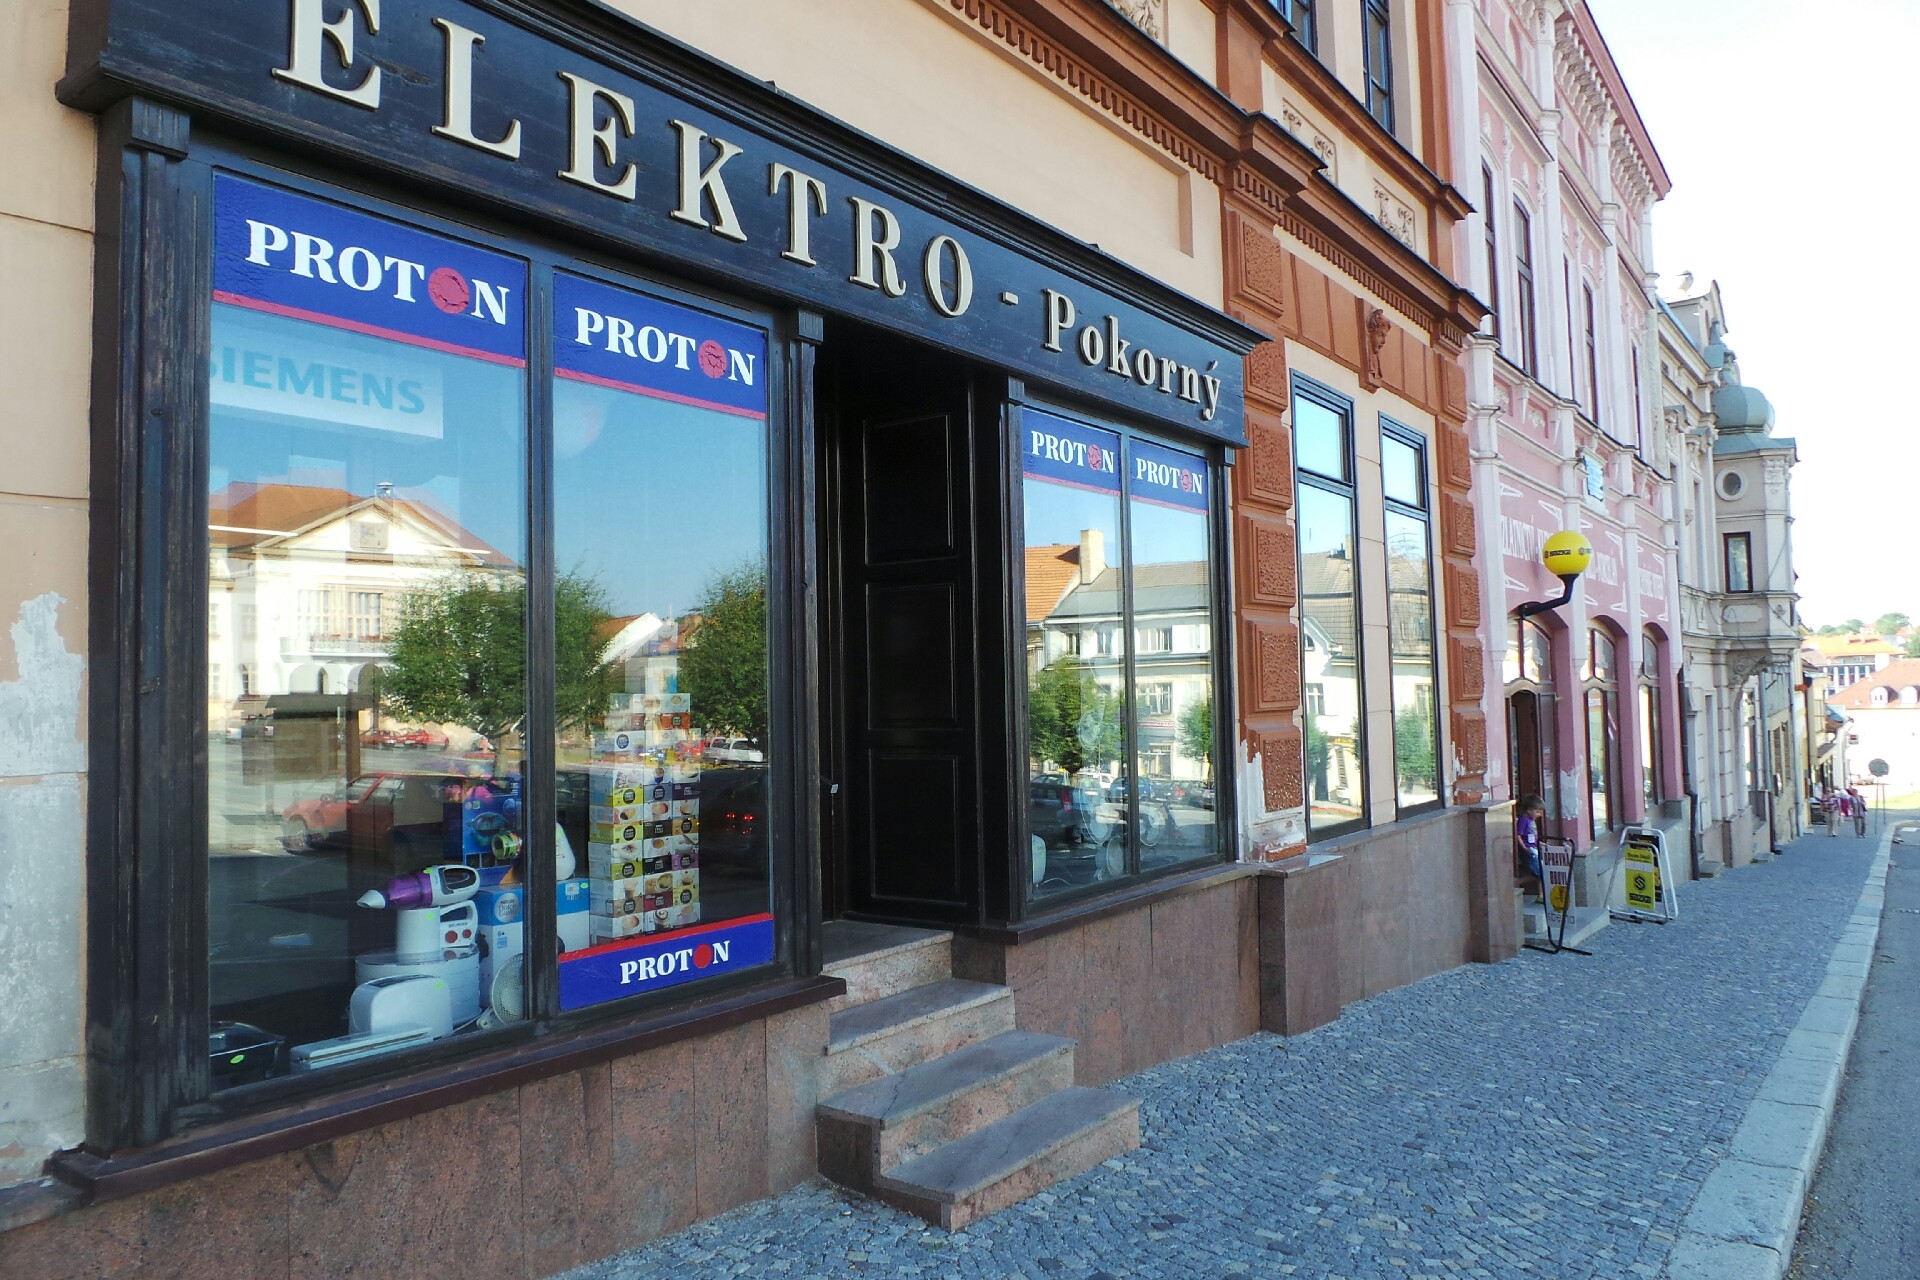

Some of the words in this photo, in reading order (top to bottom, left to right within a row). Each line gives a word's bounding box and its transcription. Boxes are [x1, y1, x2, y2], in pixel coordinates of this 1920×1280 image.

[272, 0, 973, 318] ELEKTRO
[1043, 287, 1222, 422] Pokorný
[210, 346, 425, 415] IEMENS
[619, 939, 731, 986] PROTON
